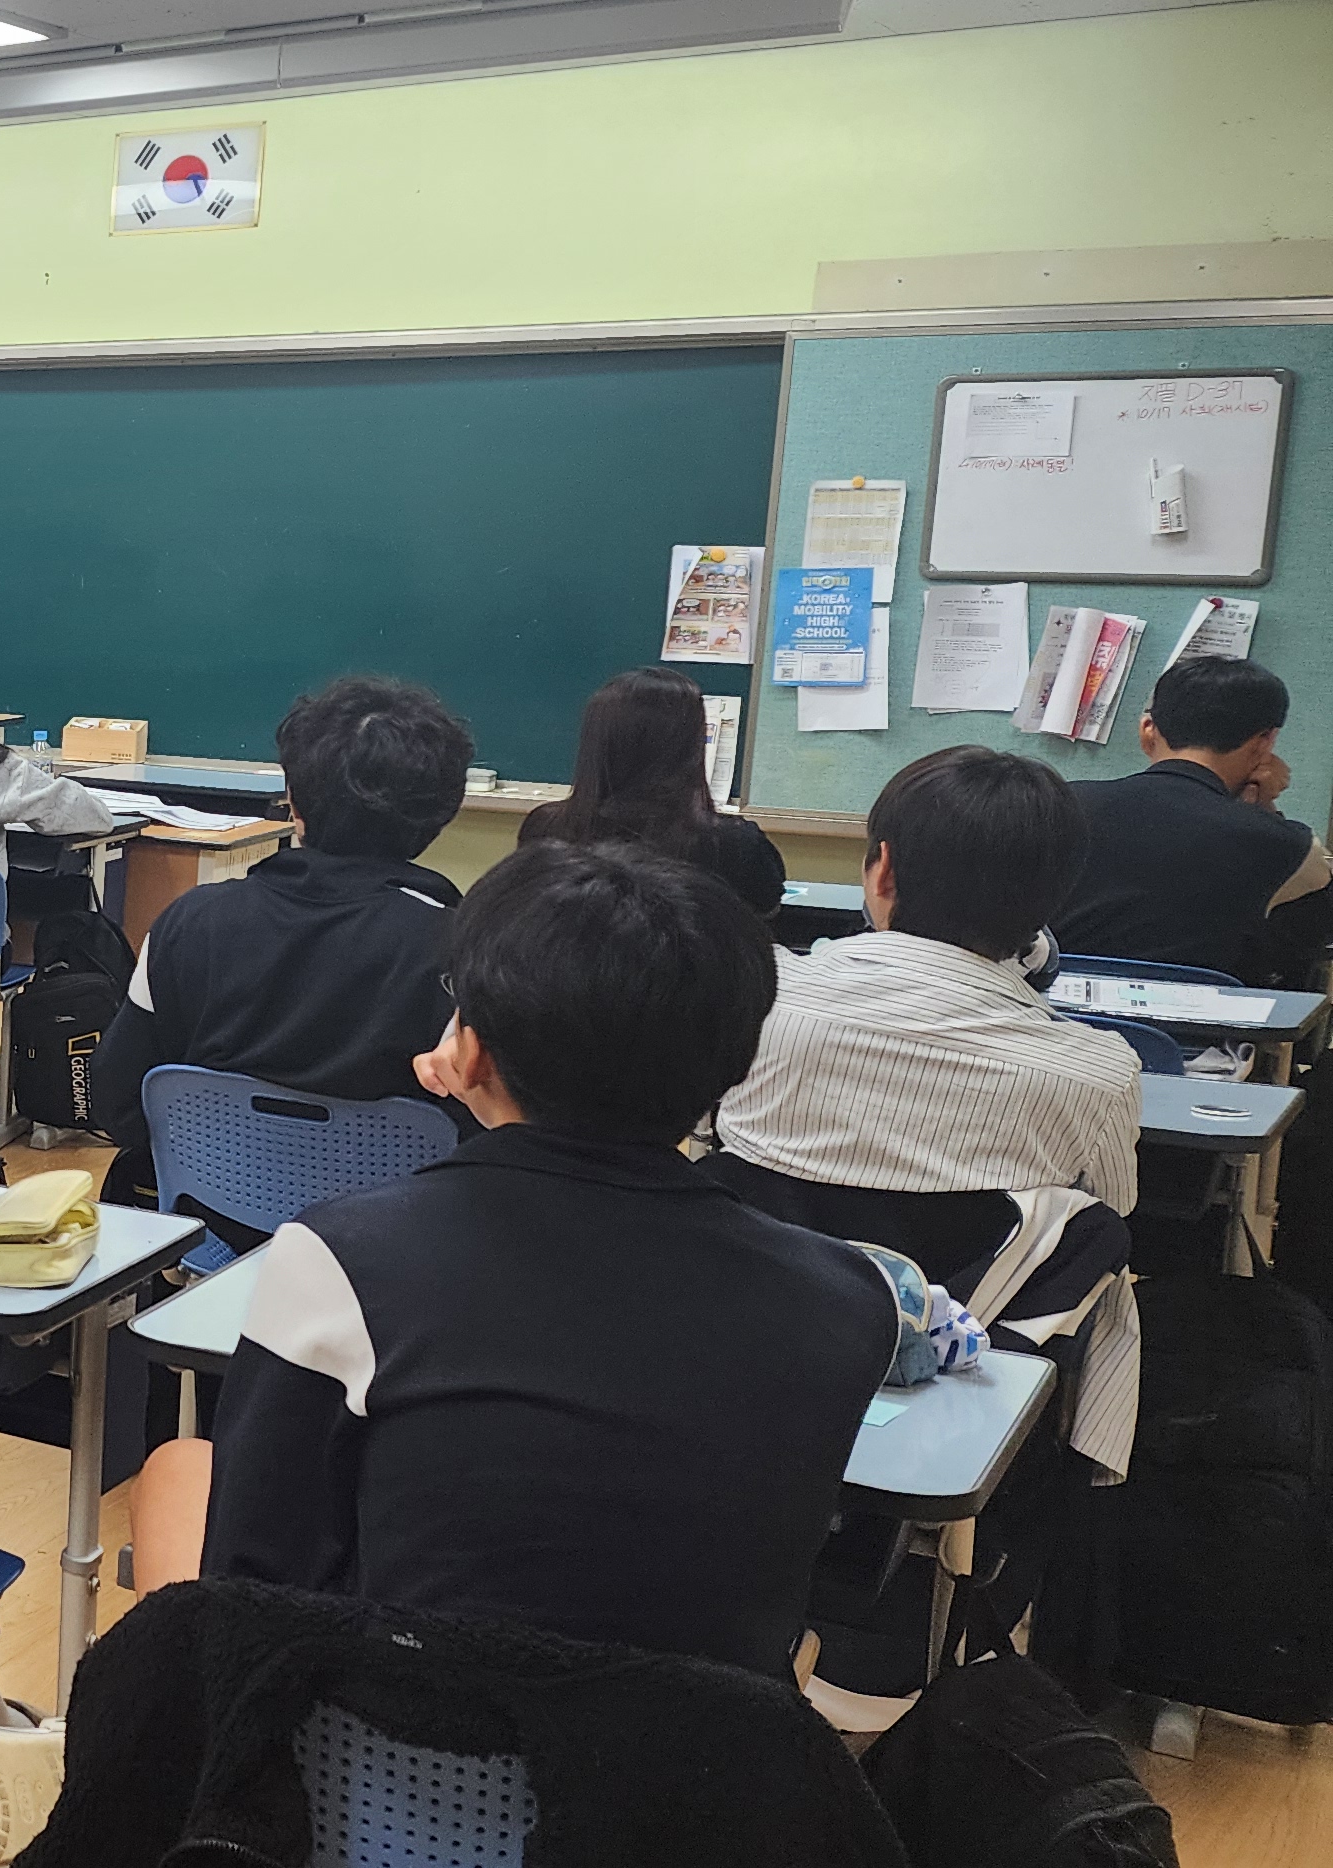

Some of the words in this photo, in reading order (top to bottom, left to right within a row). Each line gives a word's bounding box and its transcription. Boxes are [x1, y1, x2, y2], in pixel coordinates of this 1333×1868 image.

[1138, 381, 1176, 403] 지필
[1186, 379, 1243, 402] D-37
[1137, 406, 1171, 419] 10/17
[802, 593, 846, 604] KOREA
[793, 605, 854, 615] MOBILITY
[807, 616, 839, 626] HIGH
[795, 627, 849, 638] SCHOOL
[70, 1056, 89, 1121] GEOGRAPHIC
